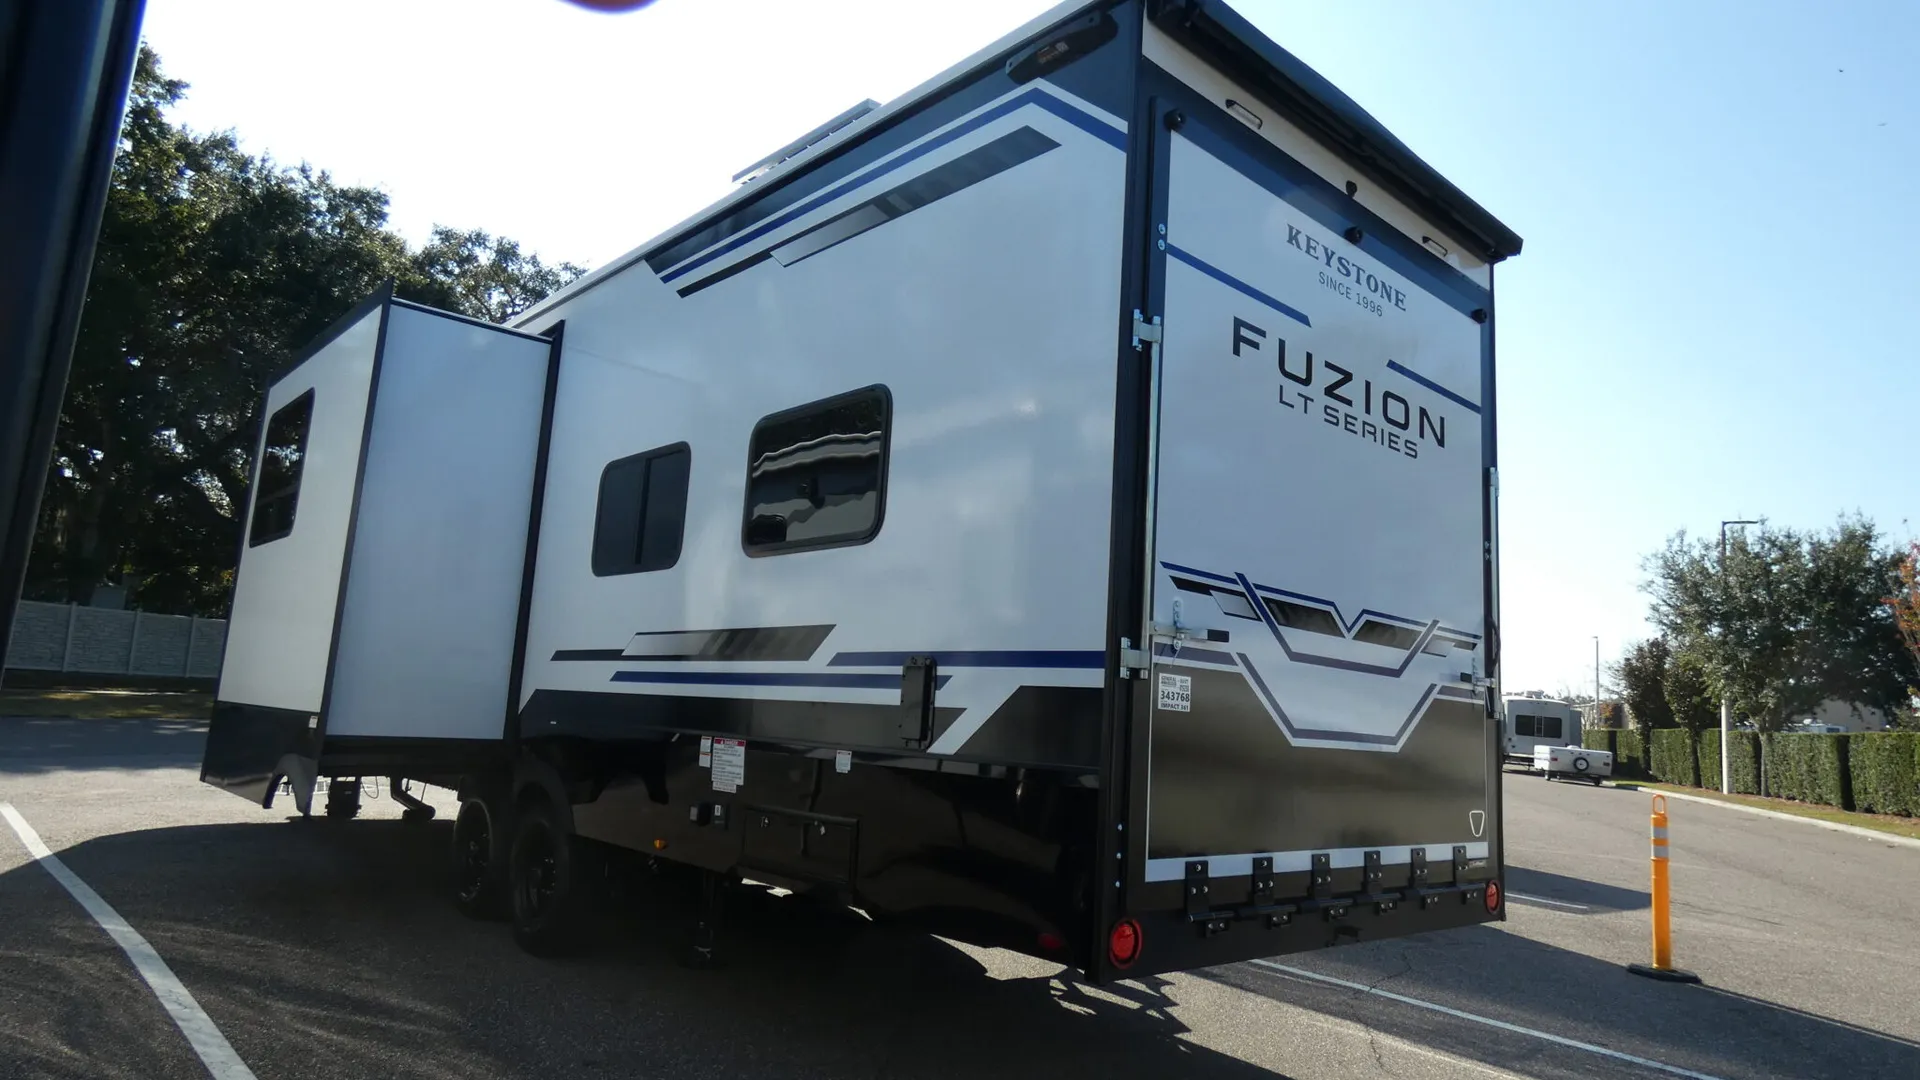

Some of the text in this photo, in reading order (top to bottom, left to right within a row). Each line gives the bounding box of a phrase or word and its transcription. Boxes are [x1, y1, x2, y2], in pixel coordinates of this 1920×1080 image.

[1286, 223, 1407, 312] KEYSTONE
[1318, 271, 1383, 317] SINCE 1996
[1232, 315, 1445, 449] FUZION
[1278, 384, 1418, 459] LT SERIES
[1160, 690, 1190, 702] 343768
[1160, 702, 1179, 710] IMPACT
